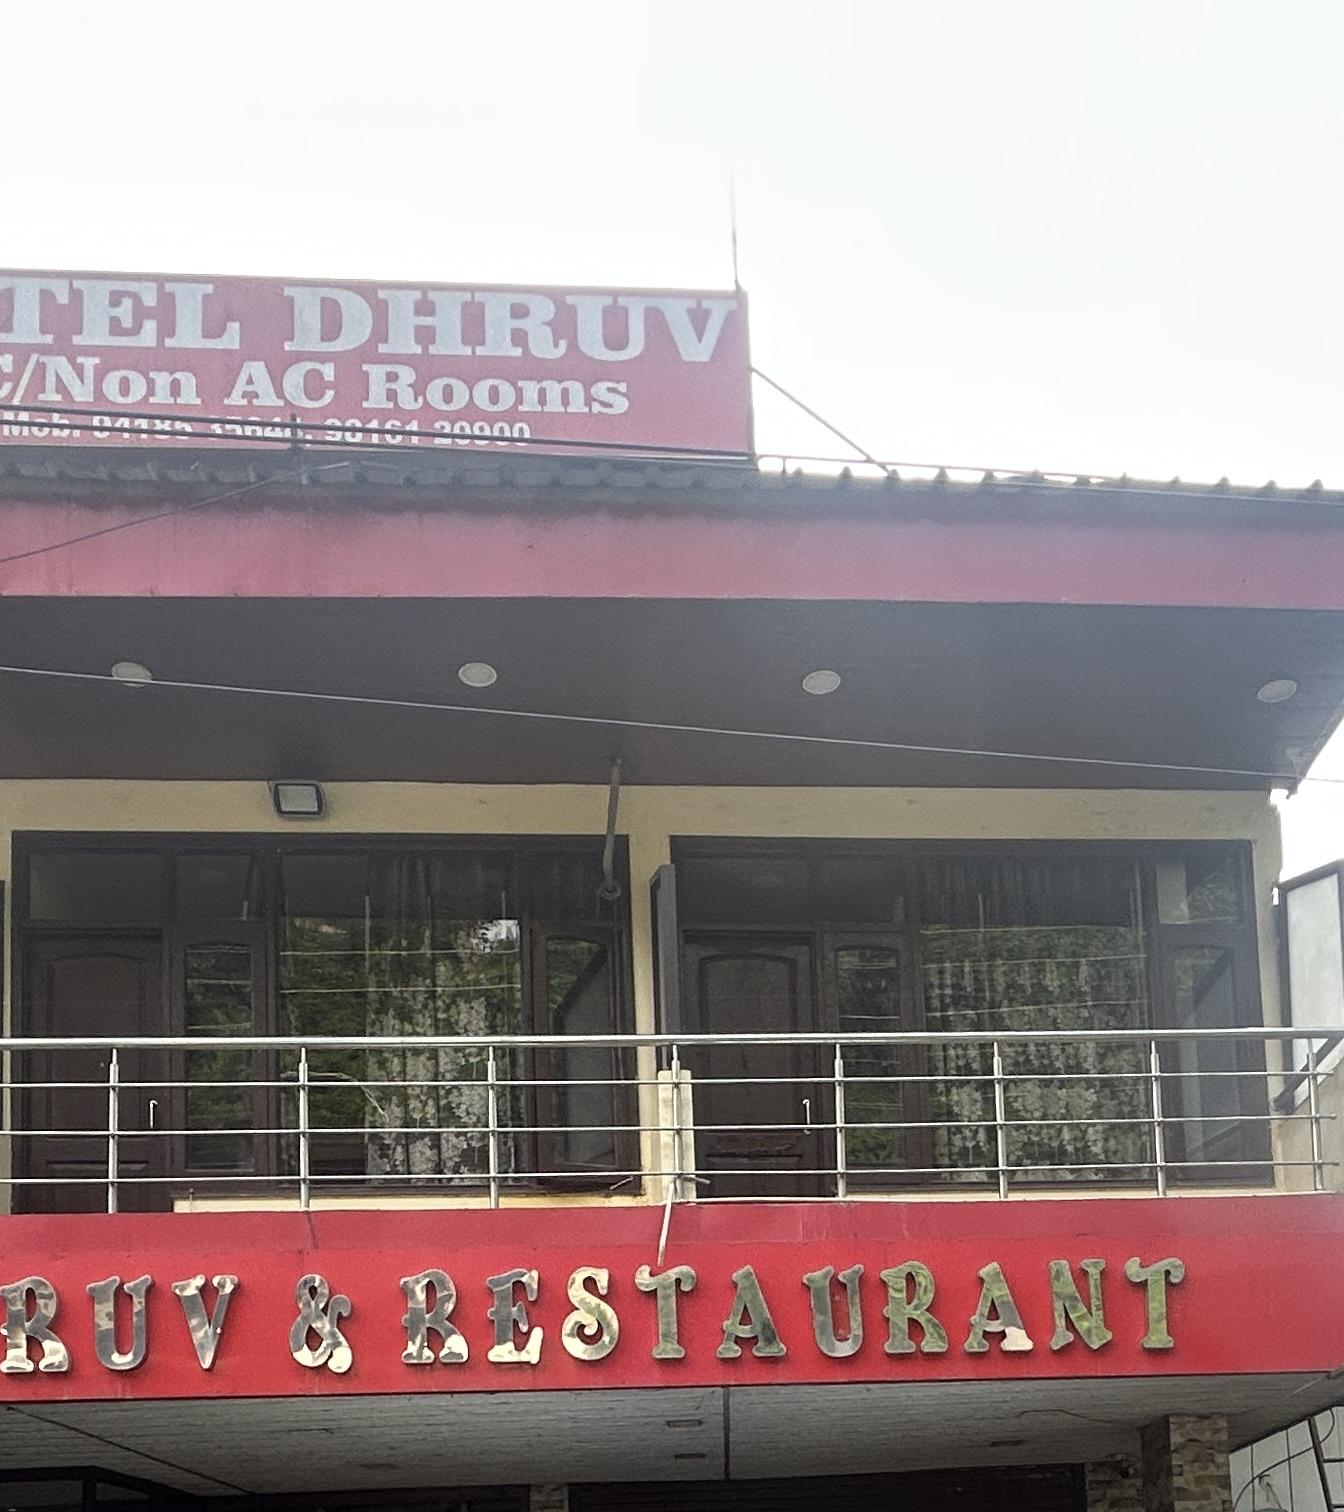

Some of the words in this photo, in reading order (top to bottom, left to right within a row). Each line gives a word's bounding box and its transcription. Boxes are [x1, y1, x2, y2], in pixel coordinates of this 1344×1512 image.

[283, 285, 738, 362] DHRUV
[223, 360, 336, 408] AC
[362, 363, 630, 415] Rooms
[1, 410, 81, 438] Mob.
[288, 1272, 354, 1374] &
[400, 1256, 1186, 1366] RESTAURANT
